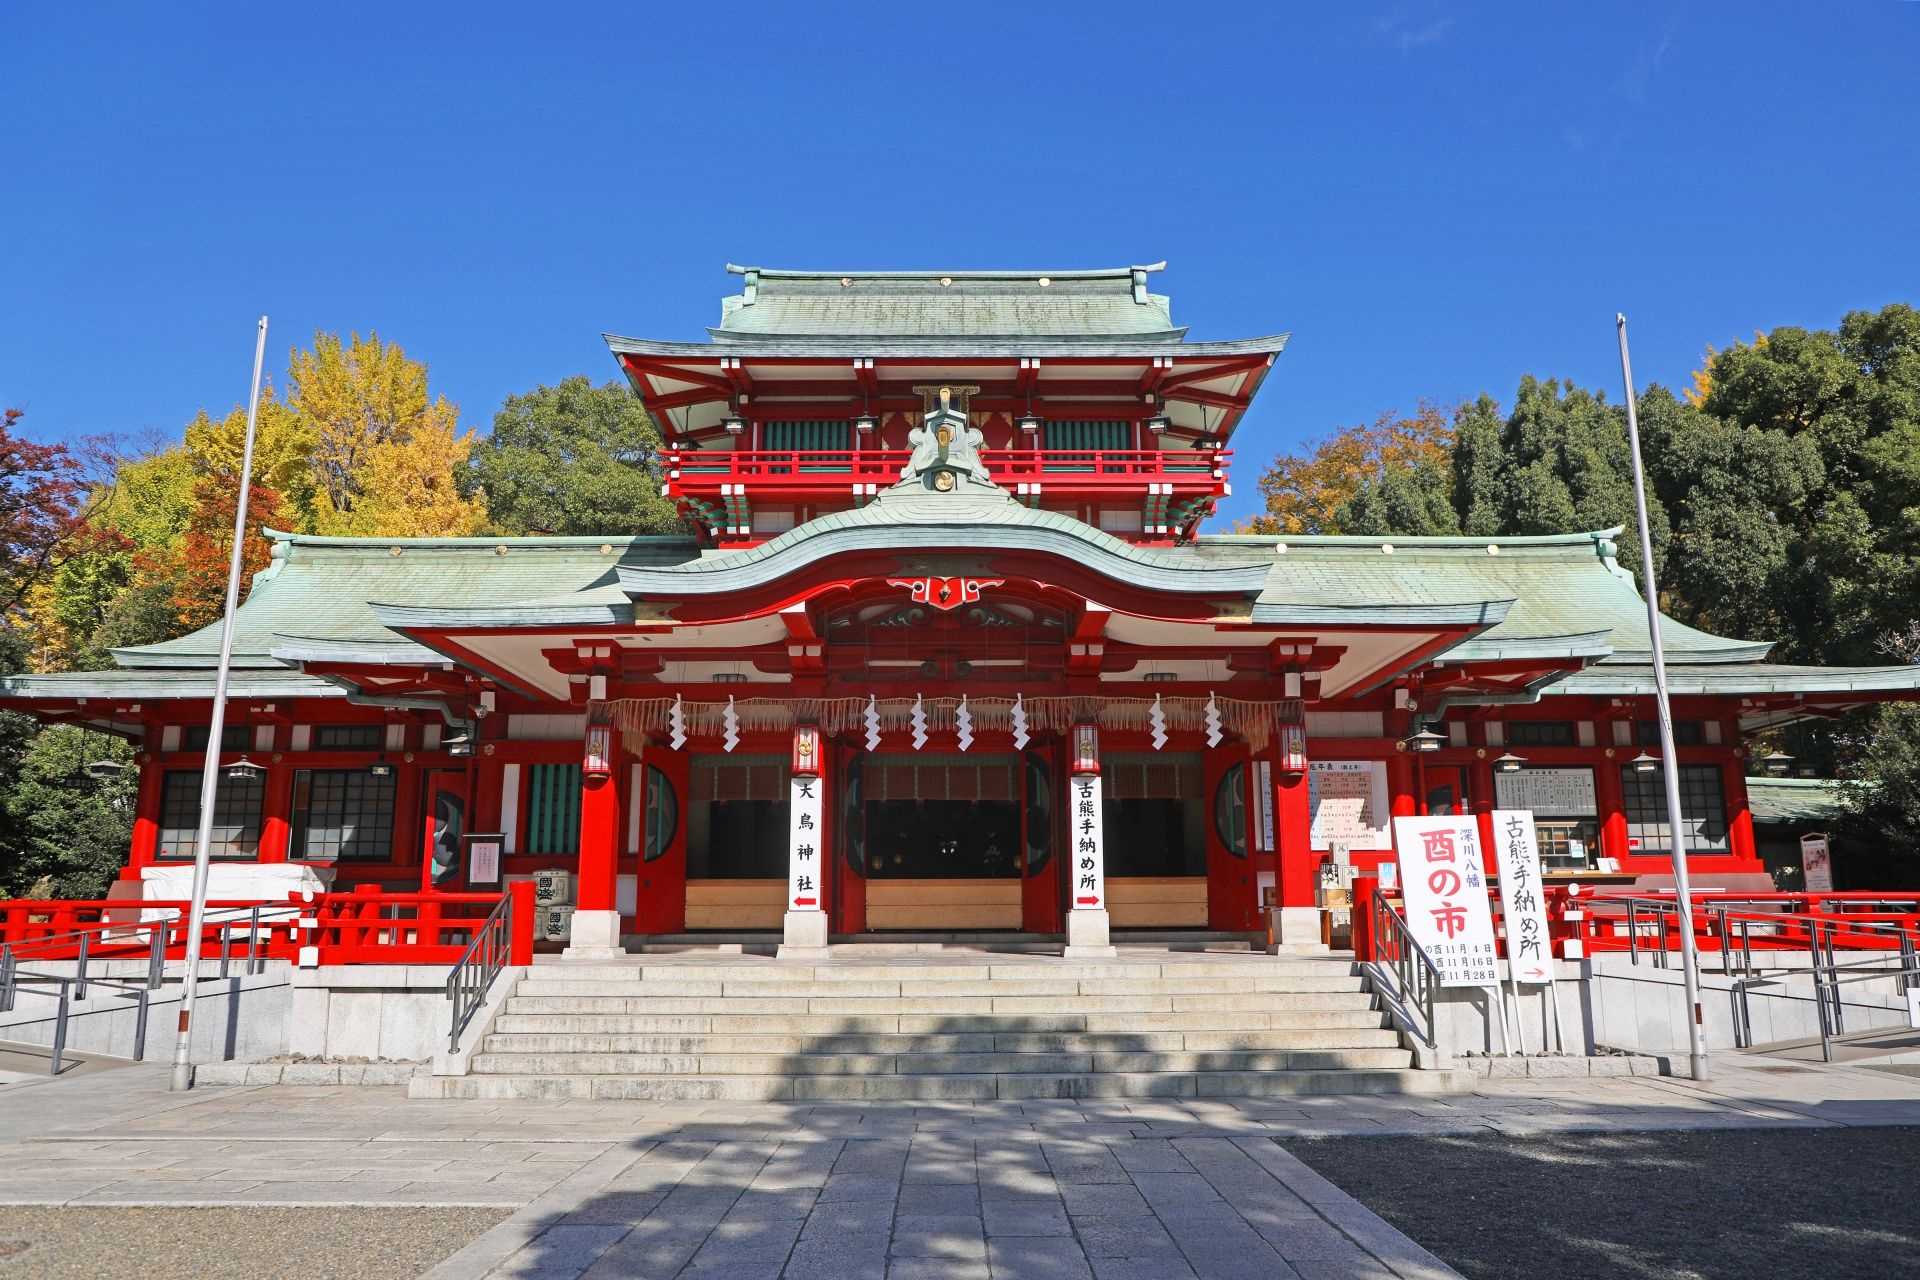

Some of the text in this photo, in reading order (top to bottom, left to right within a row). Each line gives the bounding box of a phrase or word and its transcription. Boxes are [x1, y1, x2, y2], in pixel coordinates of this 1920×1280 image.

[797, 783, 815, 892] 大鳥神社
[1078, 781, 1097, 891] 古熊手納め所
[1418, 828, 1468, 940] 酉の市
[1459, 828, 1480, 888] 深川八幡
[1505, 815, 1541, 961] 古熊手納め所
